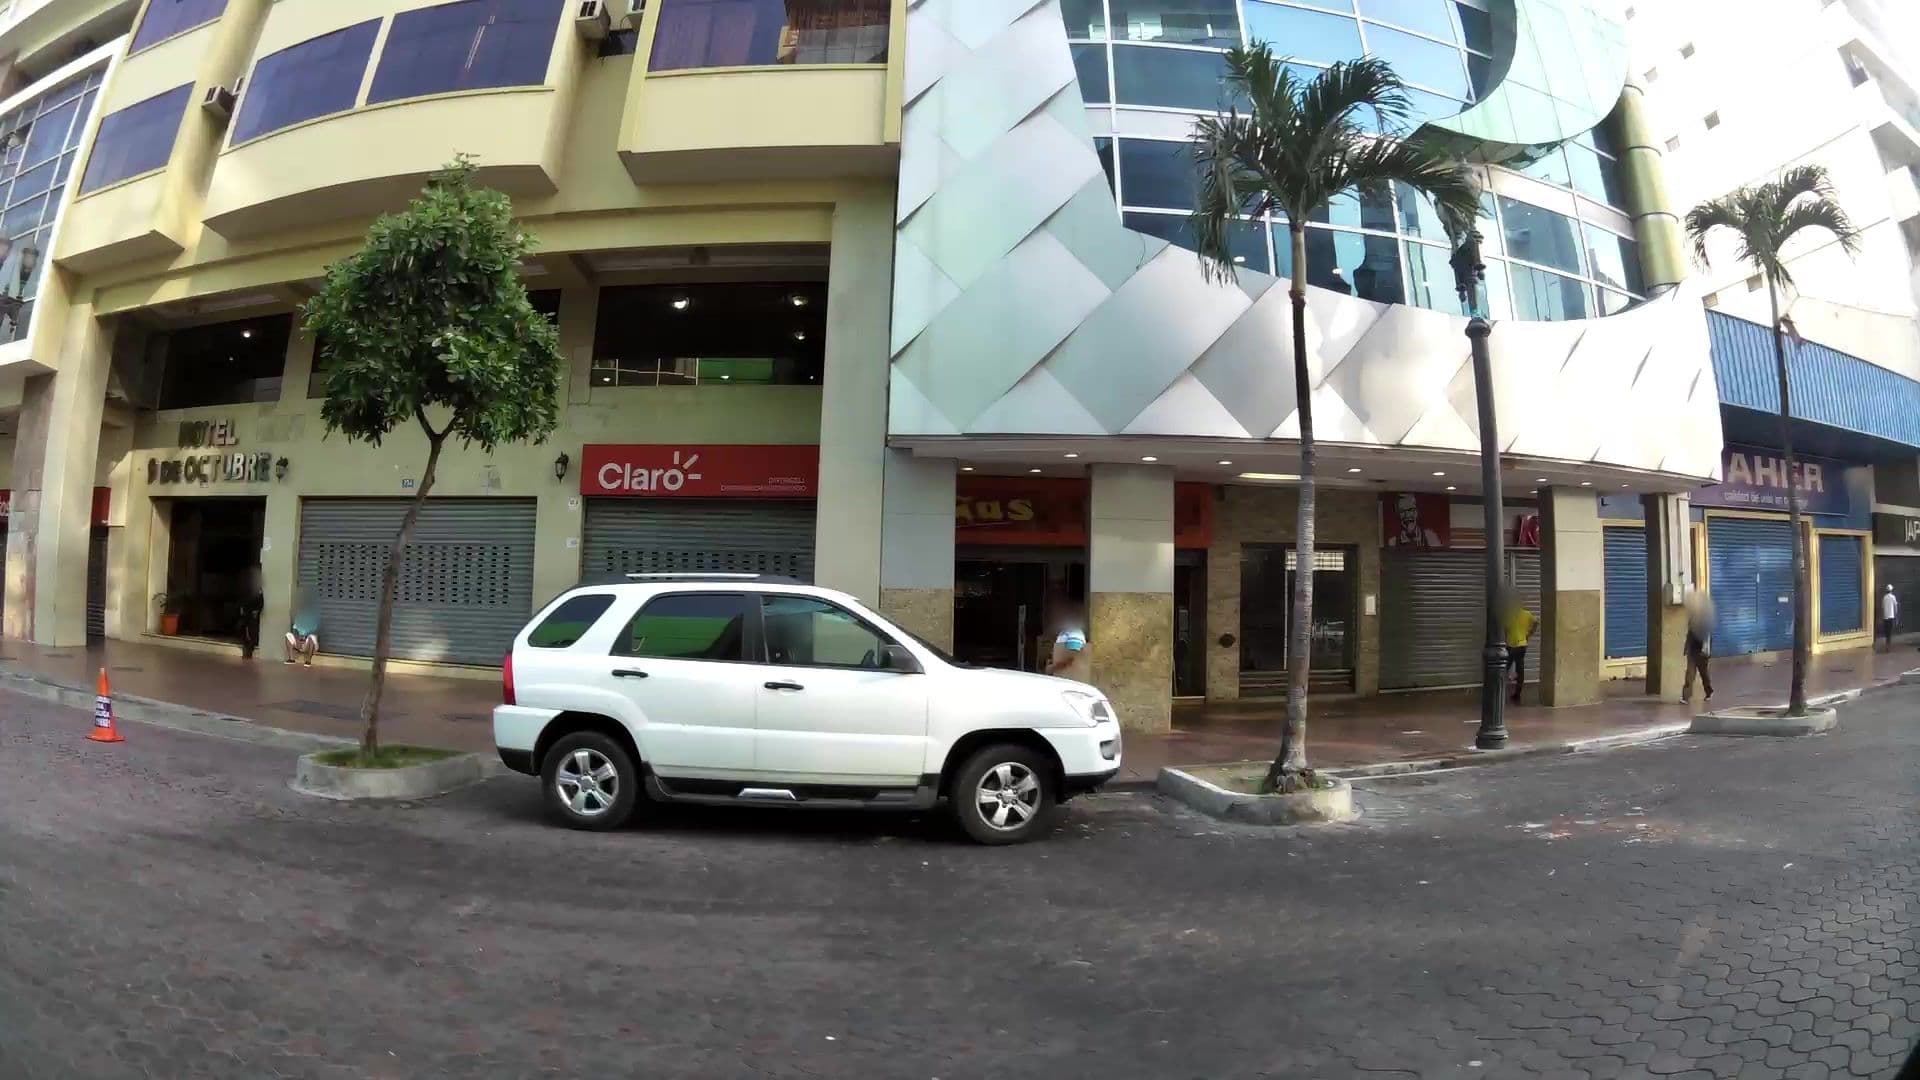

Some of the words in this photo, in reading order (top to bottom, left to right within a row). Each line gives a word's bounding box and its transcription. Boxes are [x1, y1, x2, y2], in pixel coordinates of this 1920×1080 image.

[178, 419, 239, 448] HOTEL
[184, 452, 272, 483] OCTUBRE
[598, 462, 684, 491] Claro
